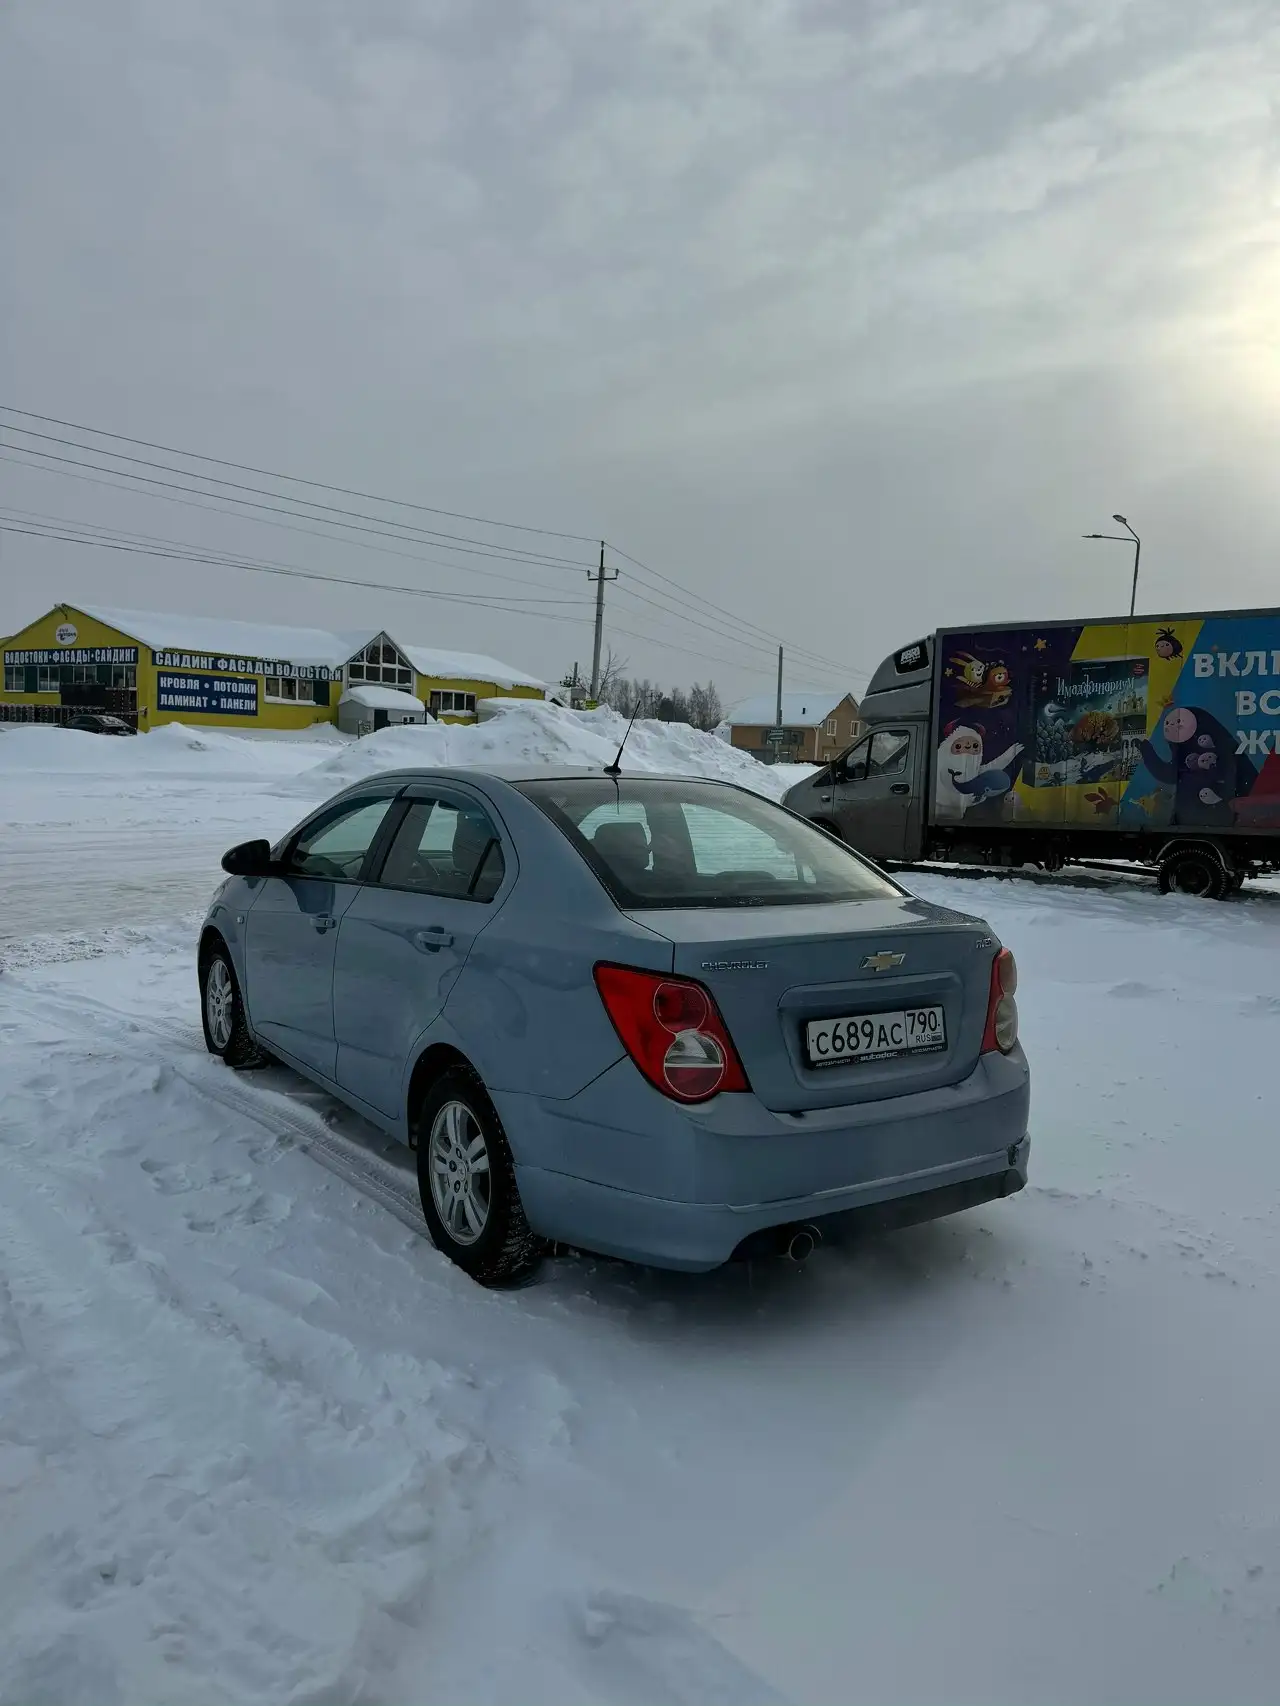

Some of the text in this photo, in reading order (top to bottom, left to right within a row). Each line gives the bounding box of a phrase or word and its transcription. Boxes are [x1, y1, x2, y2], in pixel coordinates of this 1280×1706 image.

[5, 646, 136, 664] ВОДОСТОКИ ФАСАДЫ САЙДИНГ
[155, 652, 342, 682] САЙДИНГ ФАСАДЫ ВОДОСТОКИ
[160, 676, 257, 695] КРОВЛЯ ПОТОЛКИ
[160, 694, 257, 711] ЛАМИНАТ ПАНЕЛИ
[701, 961, 770, 971] CHEVROLET
[816, 1010, 938, 1055] С689АС 790
[915, 1034, 931, 1043] RUS
